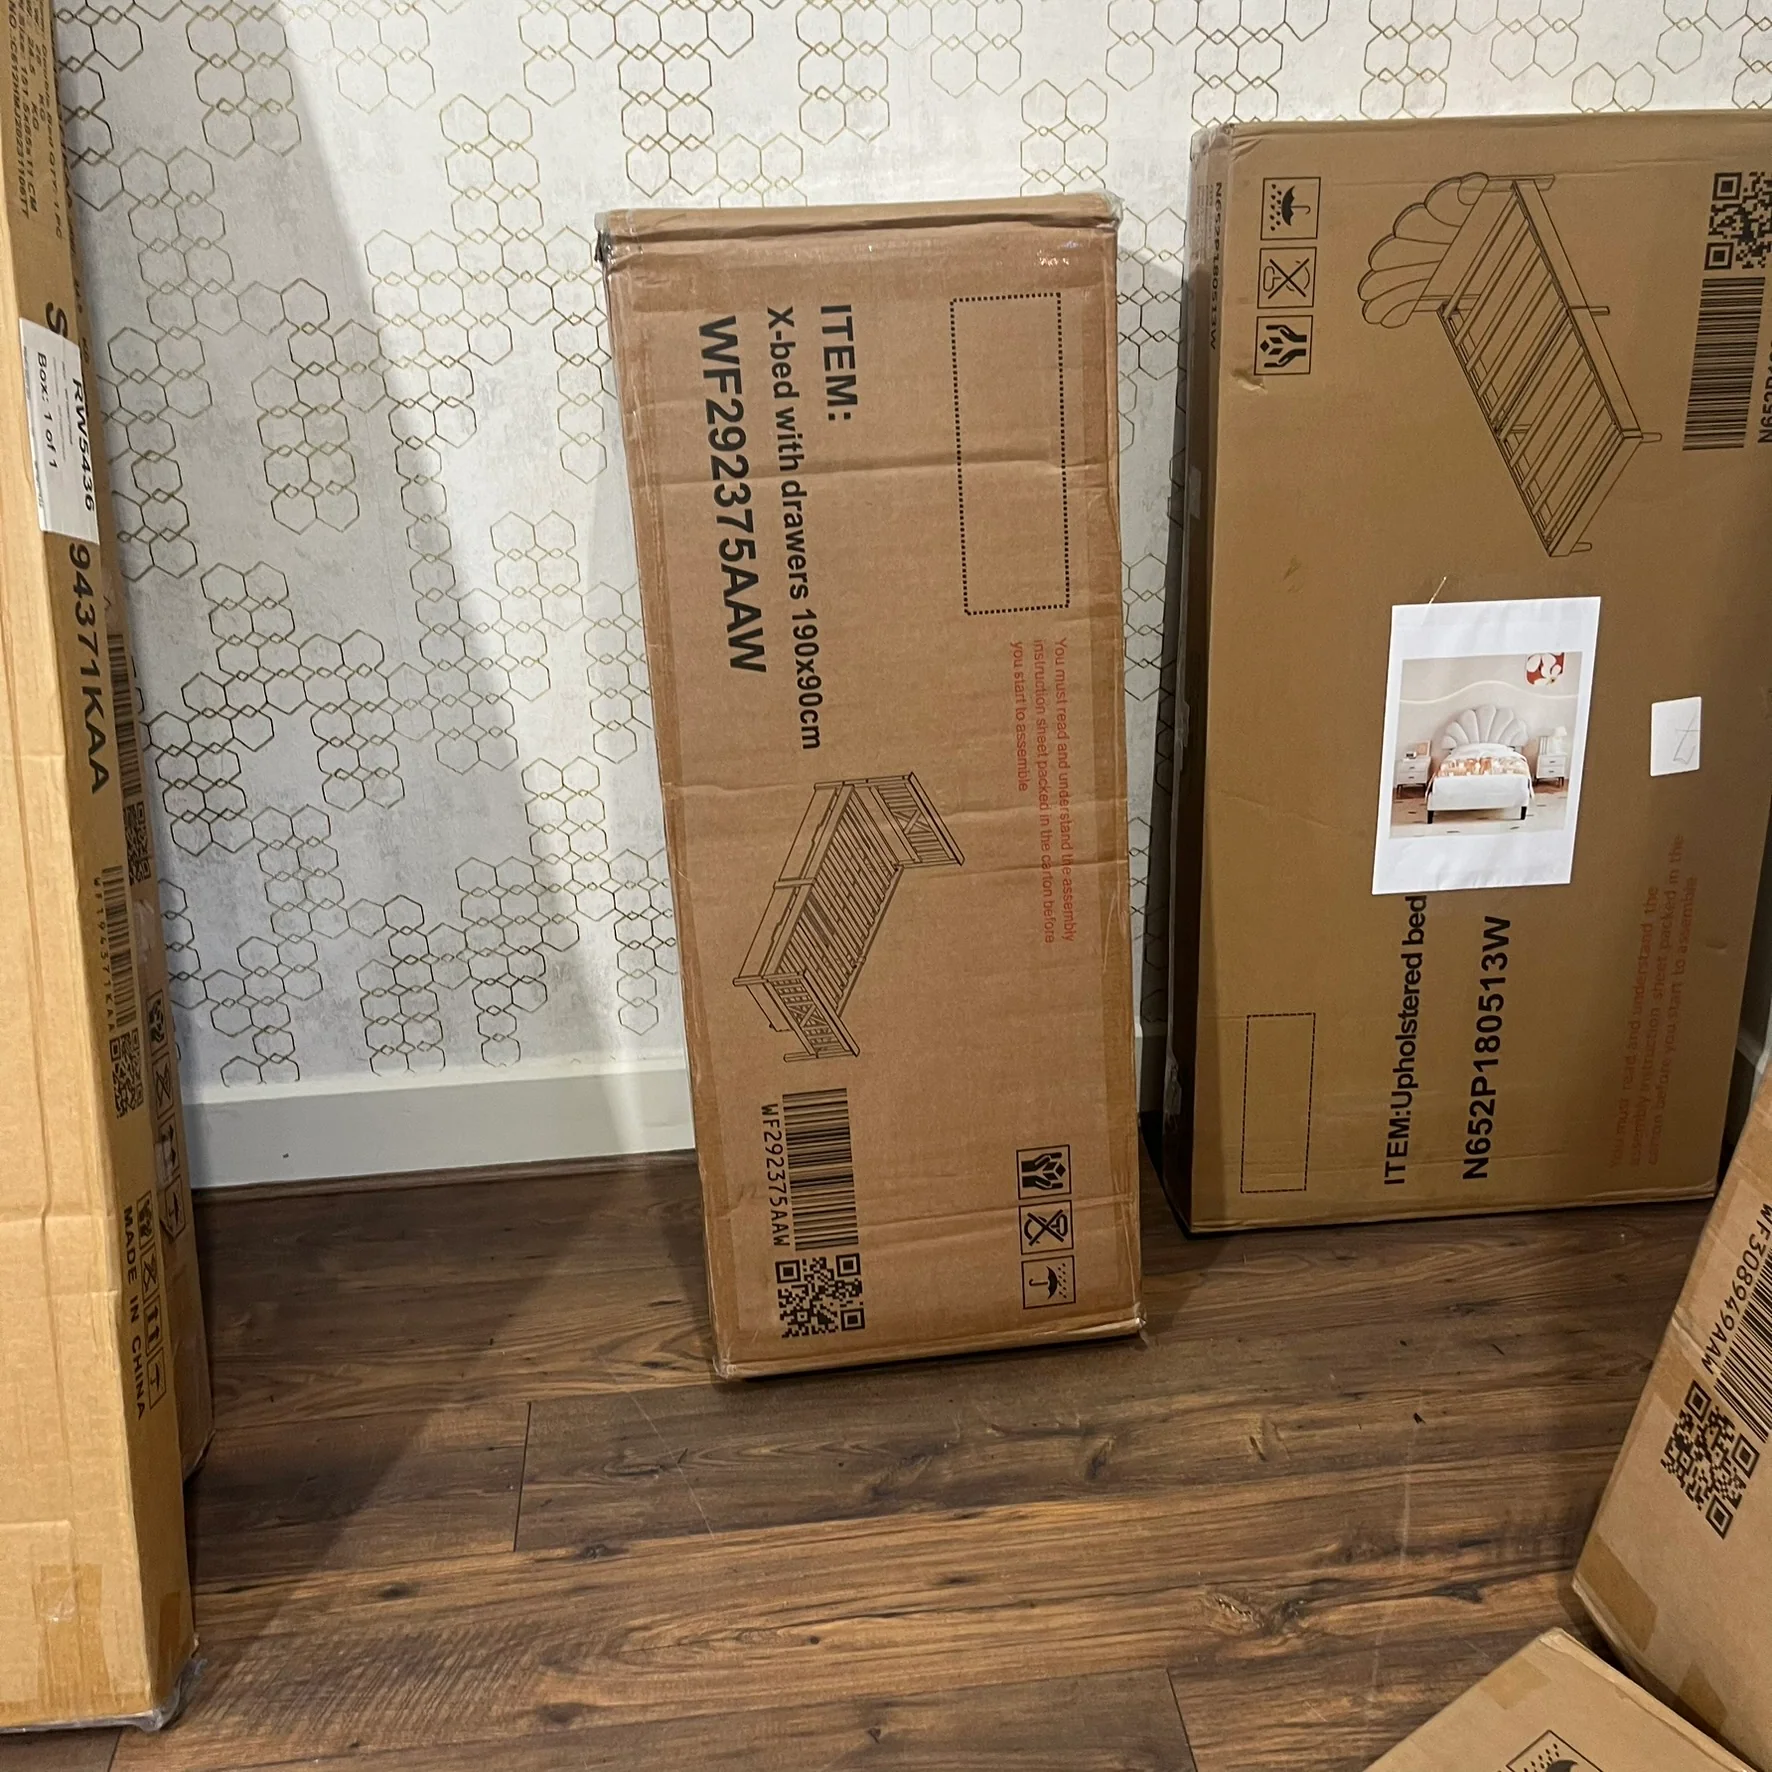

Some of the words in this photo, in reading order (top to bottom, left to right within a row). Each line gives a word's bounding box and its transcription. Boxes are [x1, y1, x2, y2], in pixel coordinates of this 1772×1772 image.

[37, 352, 49, 402] Box:
[767, 306, 800, 399] X-bed
[820, 304, 858, 421] ITEM:
[44, 411, 53, 422] 1
[45, 429, 56, 454] of
[775, 406, 804, 472] with
[48, 461, 58, 469] 1
[72, 378, 95, 512] RW5436
[699, 315, 767, 673] WF292375AAW
[780, 479, 809, 600] drawers
[1010, 641, 1024, 667] you
[1033, 639, 1049, 715] instruction
[1055, 637, 1067, 666] You
[792, 608, 823, 750] 190x90cm
[1014, 671, 1027, 704] start
[1055, 669, 1068, 704] must
[1015, 707, 1027, 721] to
[1036, 718, 1049, 757] sheet
[1056, 708, 1070, 739] read
[1016, 723, 1031, 792] assemble
[1057, 743, 1071, 769] and
[1035, 760, 1051, 812] packed
[1058, 772, 1073, 850] understand
[1039, 814, 1052, 826] in
[1040, 829, 1053, 851] the
[1041, 854, 1055, 897] carton
[1061, 854, 1073, 875] the
[1043, 900, 1057, 944] before
[1061, 880, 1077, 942] assembly
[1401, 894, 1428, 946] bed
[1633, 923, 1653, 1016] understand
[1643, 887, 1658, 915] the
[1384, 952, 1423, 1185] ITEM:Upholstered
[1462, 915, 1511, 1180] N652P180513W
[761, 1103, 790, 1247] WF292375AAW
[123, 1206, 138, 1285] MADE
[130, 1295, 140, 1324] IN
[131, 1335, 146, 1421] CHINA
